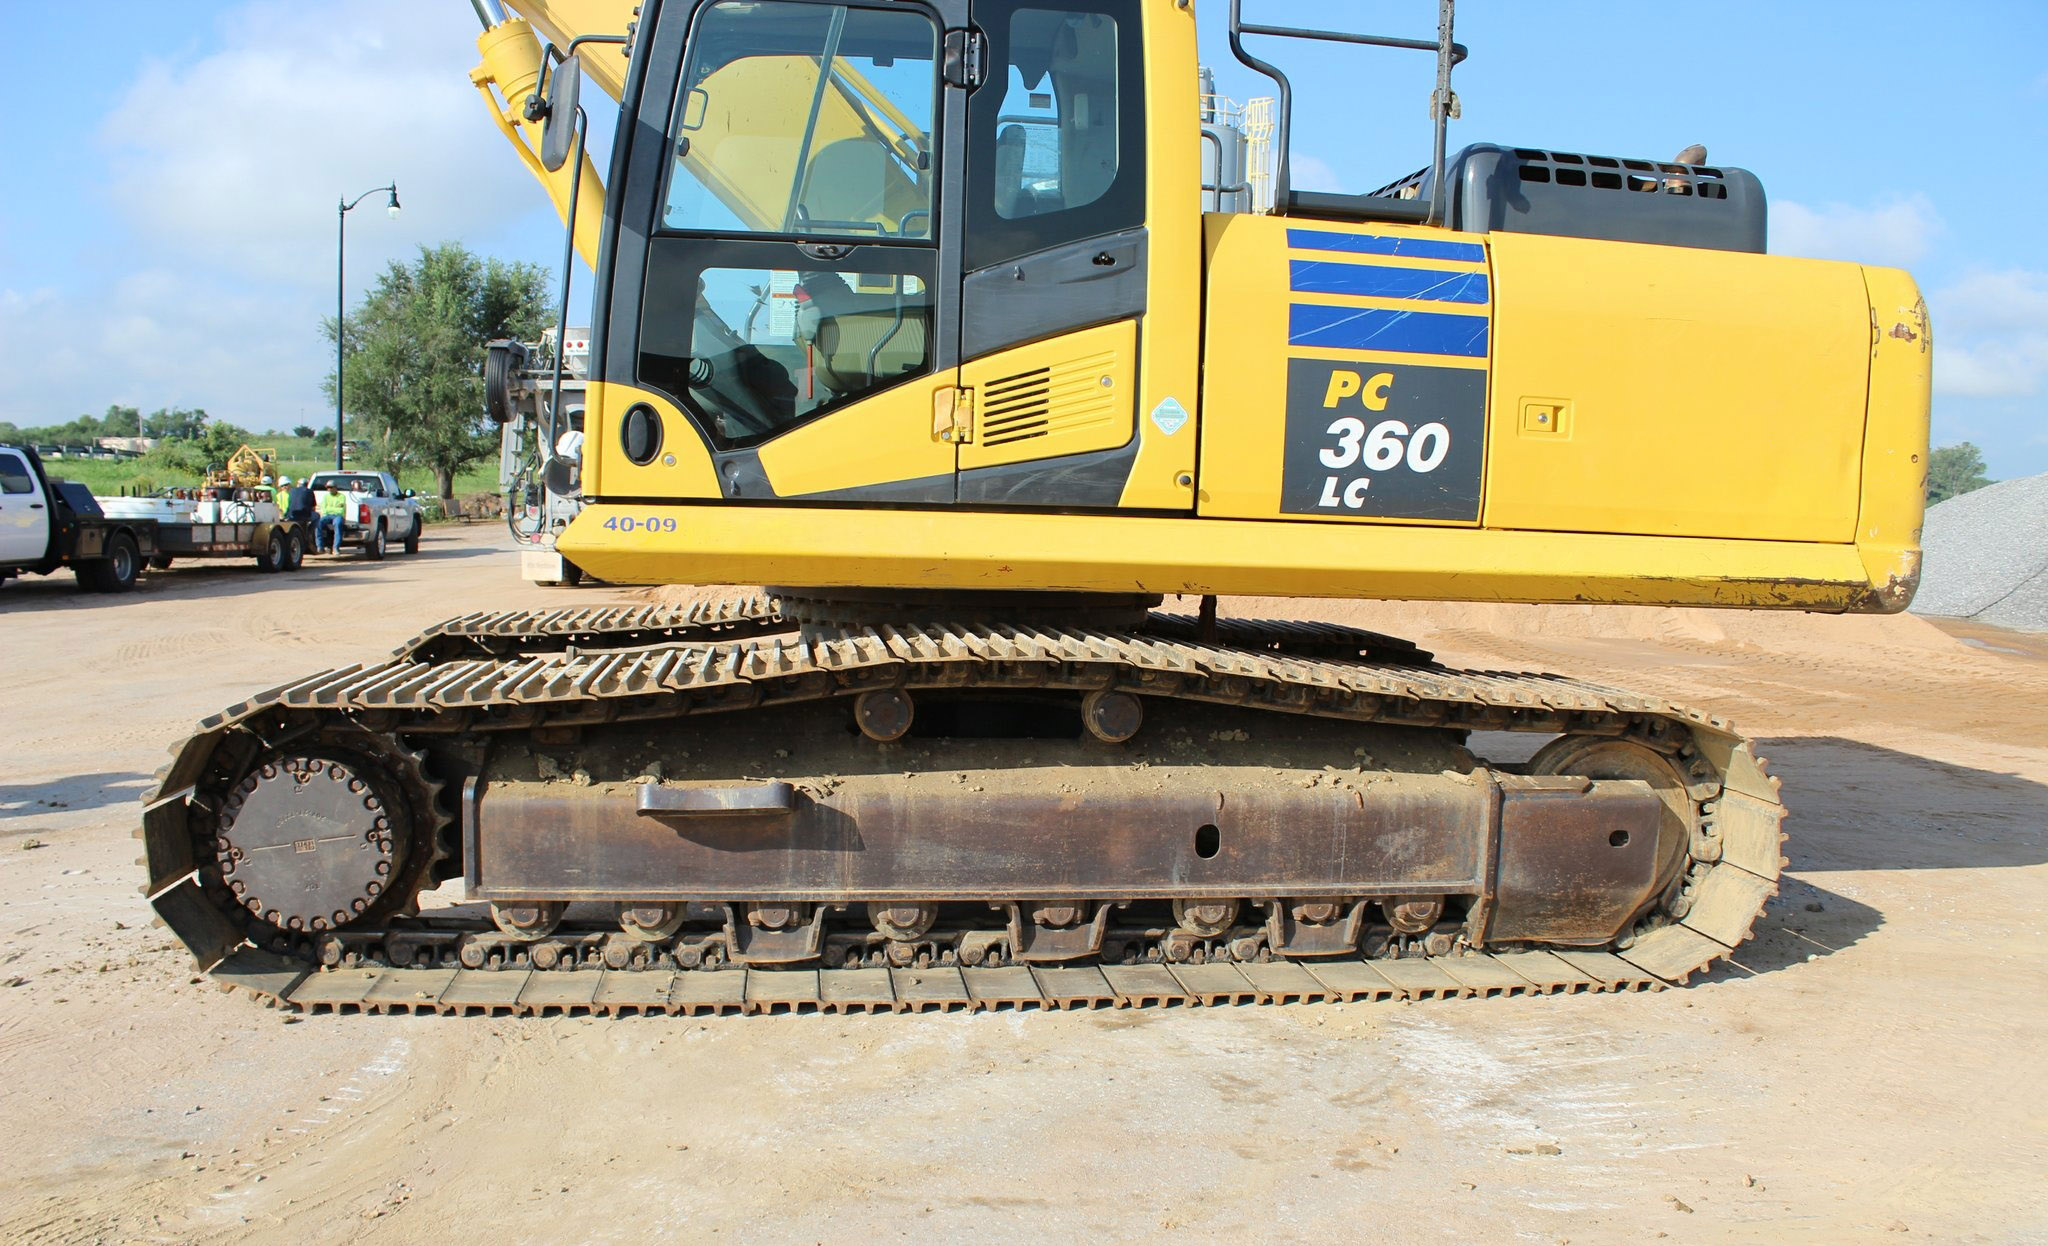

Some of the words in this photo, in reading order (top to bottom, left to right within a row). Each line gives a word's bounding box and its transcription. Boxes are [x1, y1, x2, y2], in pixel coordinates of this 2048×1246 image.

[1322, 369, 1394, 412] PC
[1318, 417, 1450, 473] 360
[1318, 476, 1371, 509] LC
[602, 516, 677, 532] 40-09
